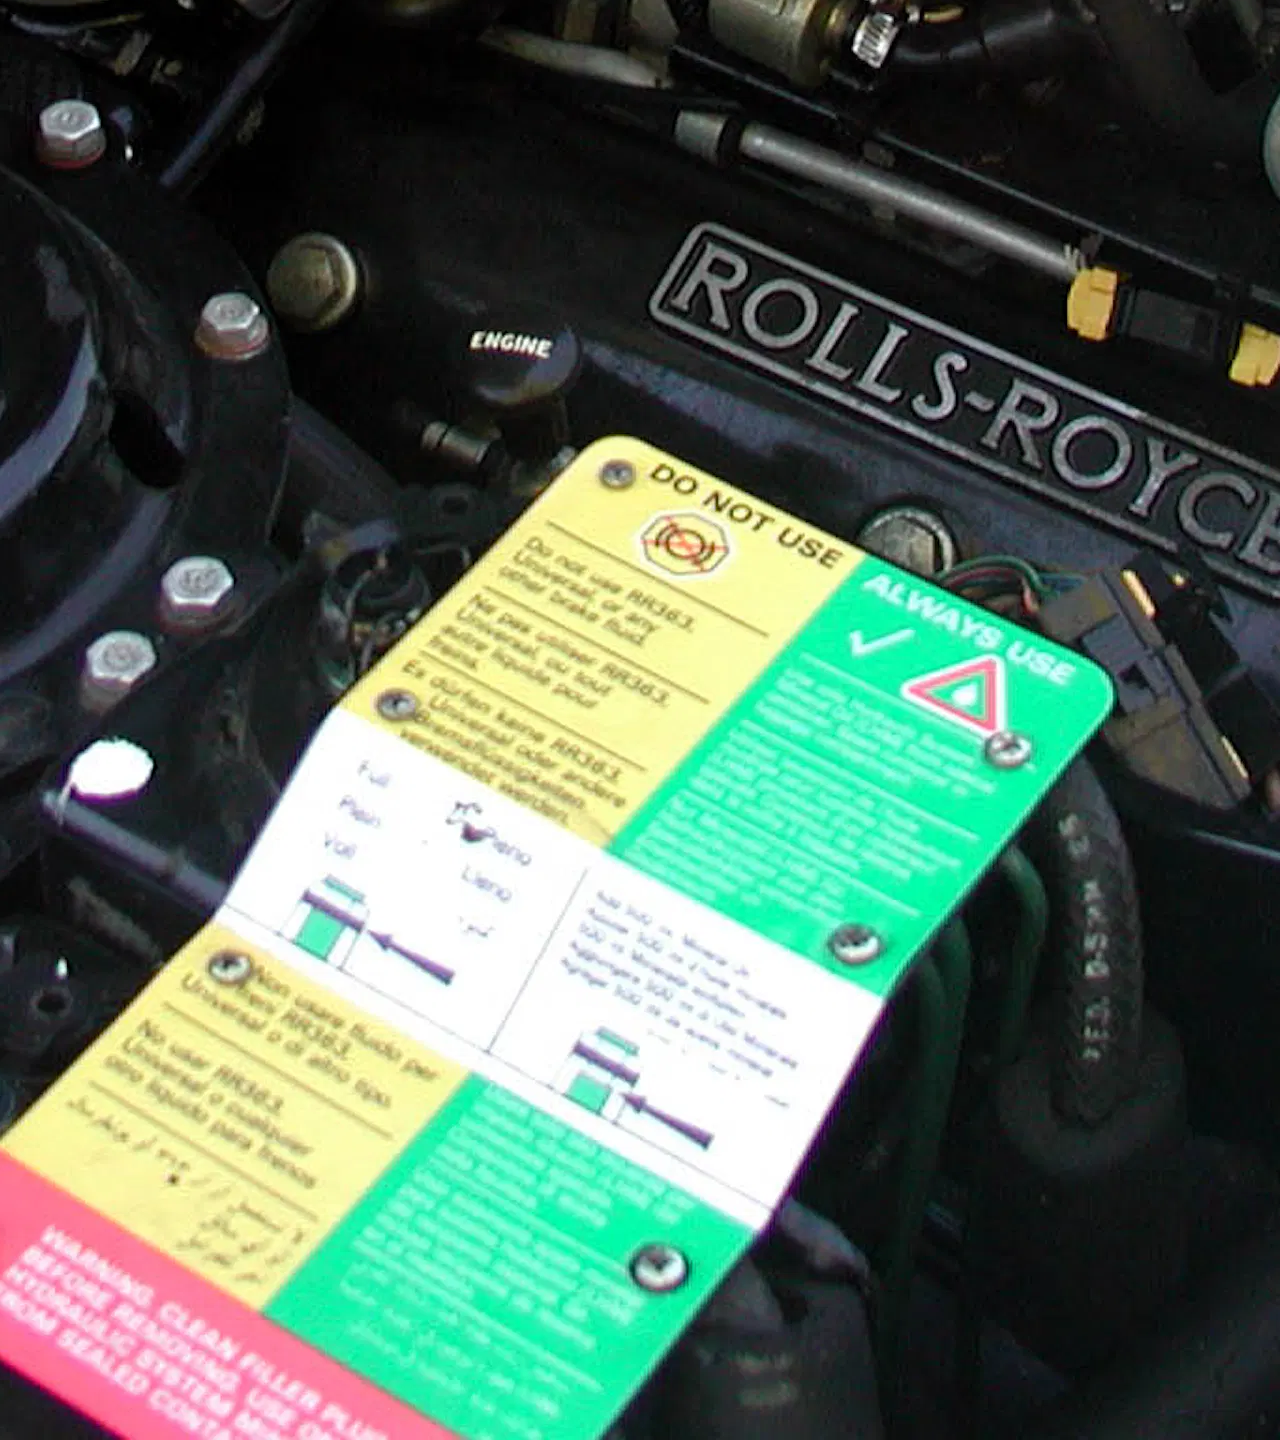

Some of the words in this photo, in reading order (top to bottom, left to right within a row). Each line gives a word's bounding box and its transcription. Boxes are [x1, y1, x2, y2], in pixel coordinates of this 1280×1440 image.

[470, 330, 554, 360] ENGINE
[524, 536, 554, 559] Do
[649, 461, 699, 497] DO
[700, 491, 780, 536] NOT
[777, 526, 845, 571] USE
[860, 572, 1005, 652] ALWAYS
[1005, 639, 1077, 686] USE
[21, 1245, 115, 1310] BEFORE
[56, 1328, 151, 1396] SEALED
[158, 1300, 241, 1362] CLEAN
[239, 1352, 323, 1412] FILLER
